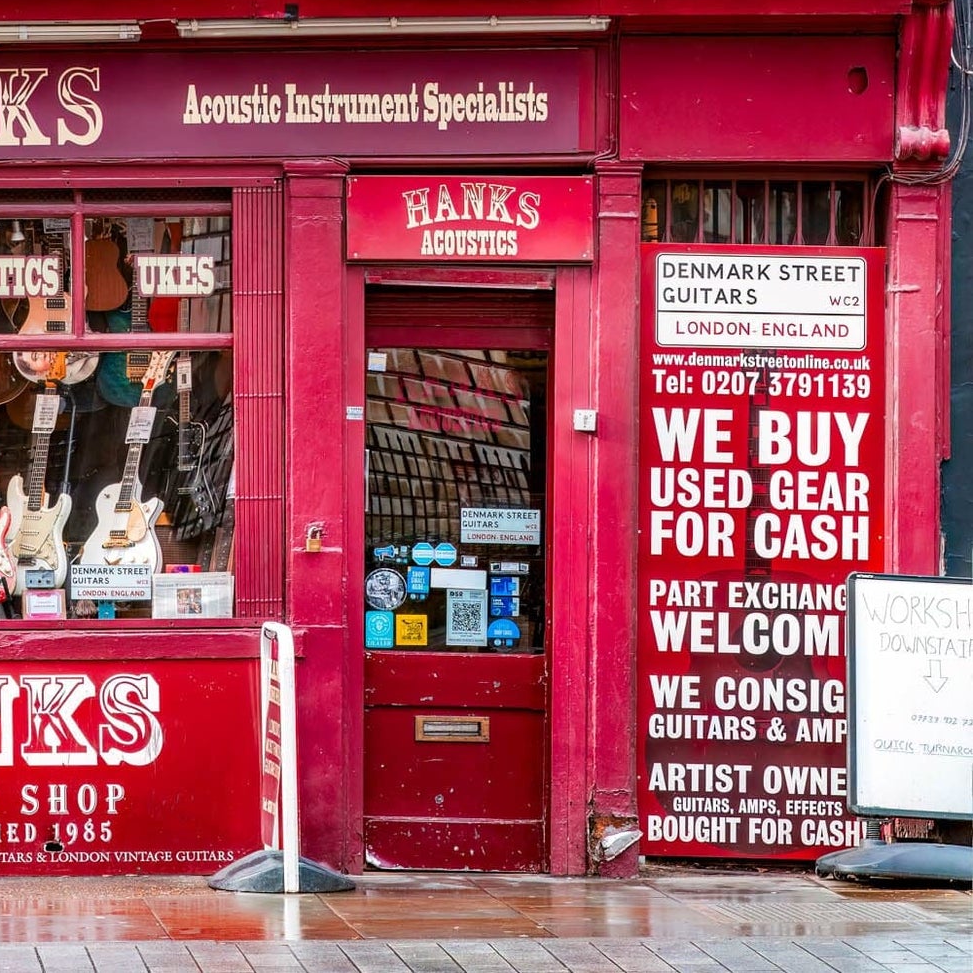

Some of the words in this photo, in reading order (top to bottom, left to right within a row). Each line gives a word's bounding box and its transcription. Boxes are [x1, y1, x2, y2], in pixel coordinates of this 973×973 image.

[183, 83, 283, 125] Acoustic
[284, 82, 420, 124] Instrument
[422, 81, 549, 131] Specialists
[402, 182, 542, 230] HANKS
[420, 229, 519, 256] ACOUSTICS
[136, 255, 215, 297] UKES
[662, 262, 771, 282] DENMARK
[778, 264, 861, 283] STREET
[662, 287, 758, 305] GUITARS
[828, 295, 861, 307] WC2
[652, 352, 871, 371] www.denmarkstreetonline.co.uk
[652, 369, 693, 394] Tel:
[701, 371, 759, 396] 0207
[768, 373, 871, 398] 3791139
[651, 407, 734, 463] WE
[758, 409, 871, 467] BUY
[650, 467, 753, 509] USED
[769, 470, 870, 512] GEAR
[462, 511, 504, 519] DENMARK
[506, 512, 538, 520] STREET
[462, 520, 499, 528] GUITARS
[650, 510, 735, 558] FOR
[753, 512, 870, 561] CASH
[72, 566, 115, 575] DENMARK
[117, 567, 149, 575] STREET
[72, 577, 110, 585] GUITARS
[649, 579, 718, 607] PART
[650, 610, 847, 657] WELCOM
[648, 675, 701, 709] WE
[648, 713, 757, 741] GUITARS
[766, 717, 787, 743] &
[648, 763, 752, 793] ARTIST
[20, 783, 126, 816] SHOP
[673, 797, 734, 815] GUITARS,
[738, 799, 781, 817] AMPS,
[786, 800, 843, 817] EFFECTS
[51, 820, 113, 844] 1985
[647, 815, 741, 843] BOUGHT
[748, 817, 792, 845] FOR
[36, 851, 47, 863] &
[50, 851, 111, 863] LONDON
[113, 851, 173, 863] VINTAGE
[175, 850, 234, 862] GUITARS
